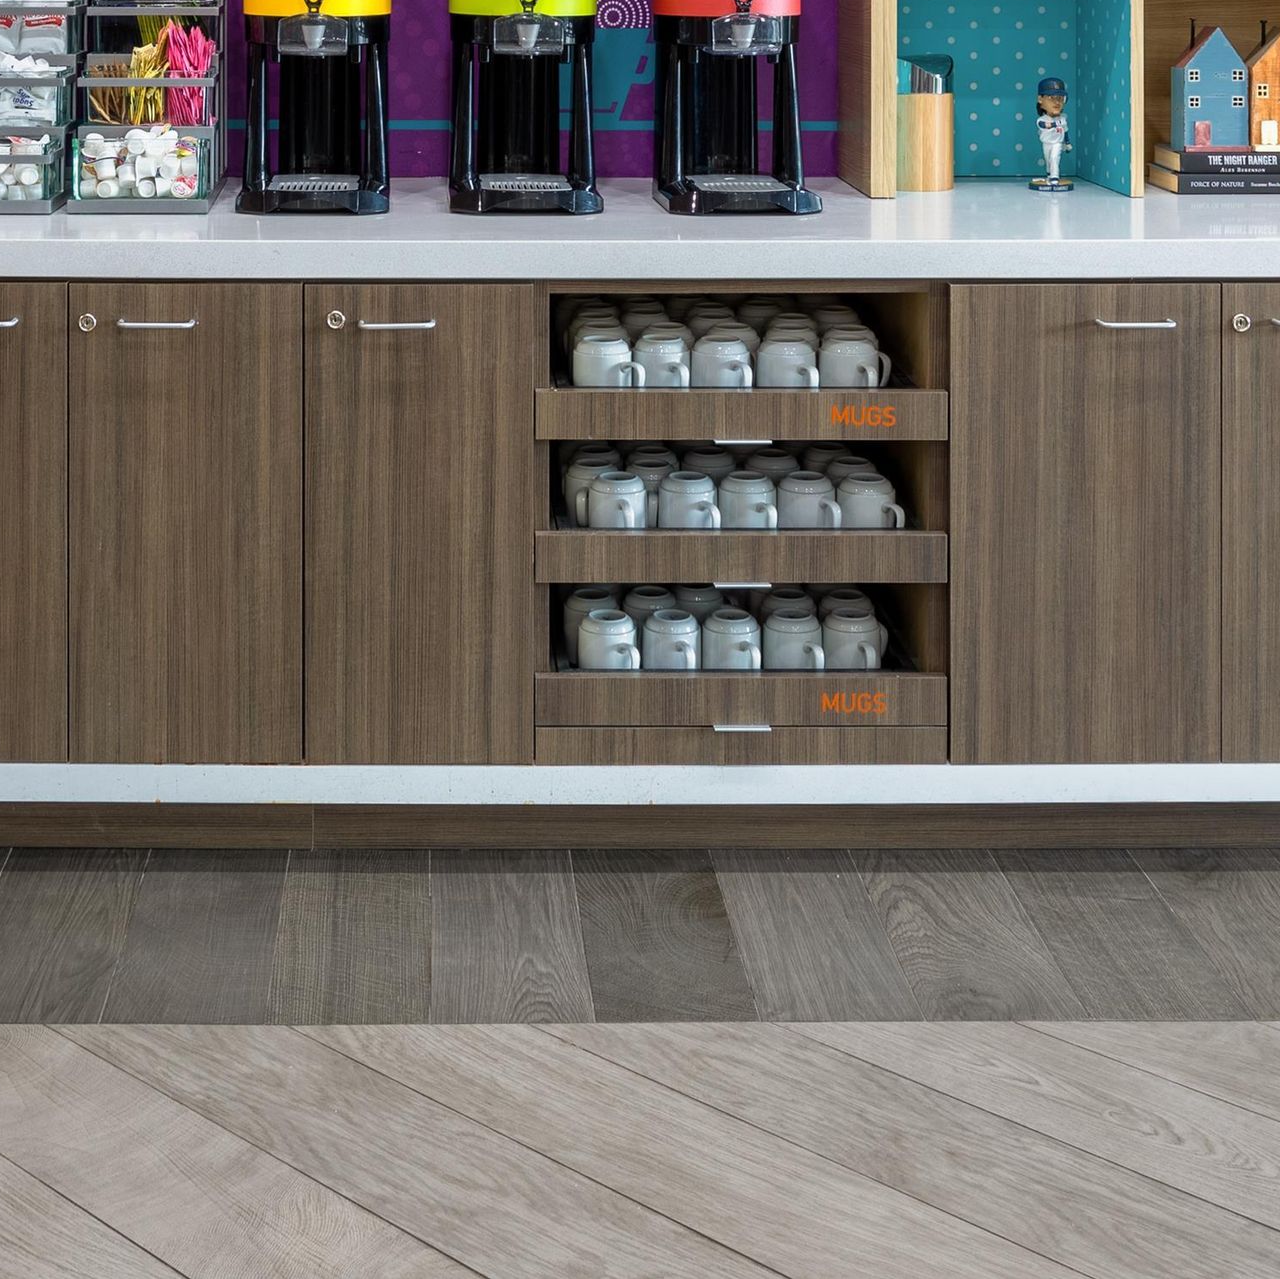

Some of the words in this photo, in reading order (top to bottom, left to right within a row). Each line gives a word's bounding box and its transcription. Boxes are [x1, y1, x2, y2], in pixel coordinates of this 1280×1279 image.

[1208, 155, 1223, 165] THE
[1224, 155, 1247, 165] NIGHT
[1248, 155, 1278, 165] RANGER
[831, 402, 897, 427] MUGS
[821, 691, 887, 714] MUGS
